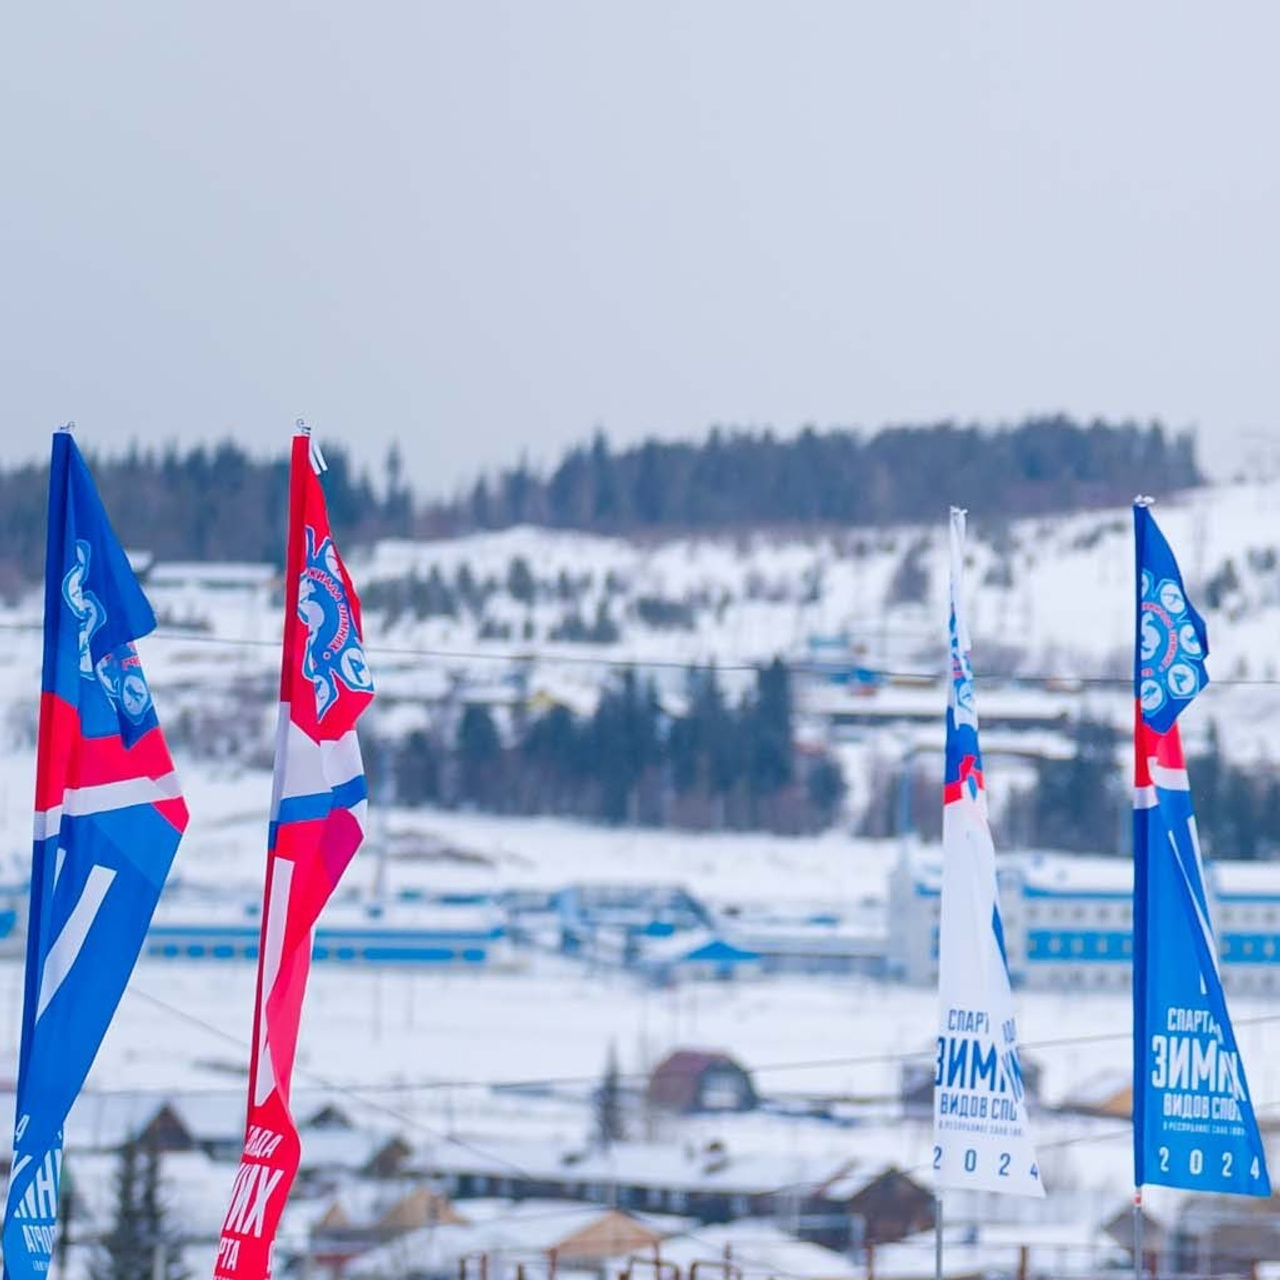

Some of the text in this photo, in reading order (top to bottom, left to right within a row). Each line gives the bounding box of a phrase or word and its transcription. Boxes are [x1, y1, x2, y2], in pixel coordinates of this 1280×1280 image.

[1167, 1007, 1224, 1044] СПАРТА
[940, 1093, 1018, 1121] ВИДОВ СПО
[1163, 1092, 1209, 1119] ВИДОВ
